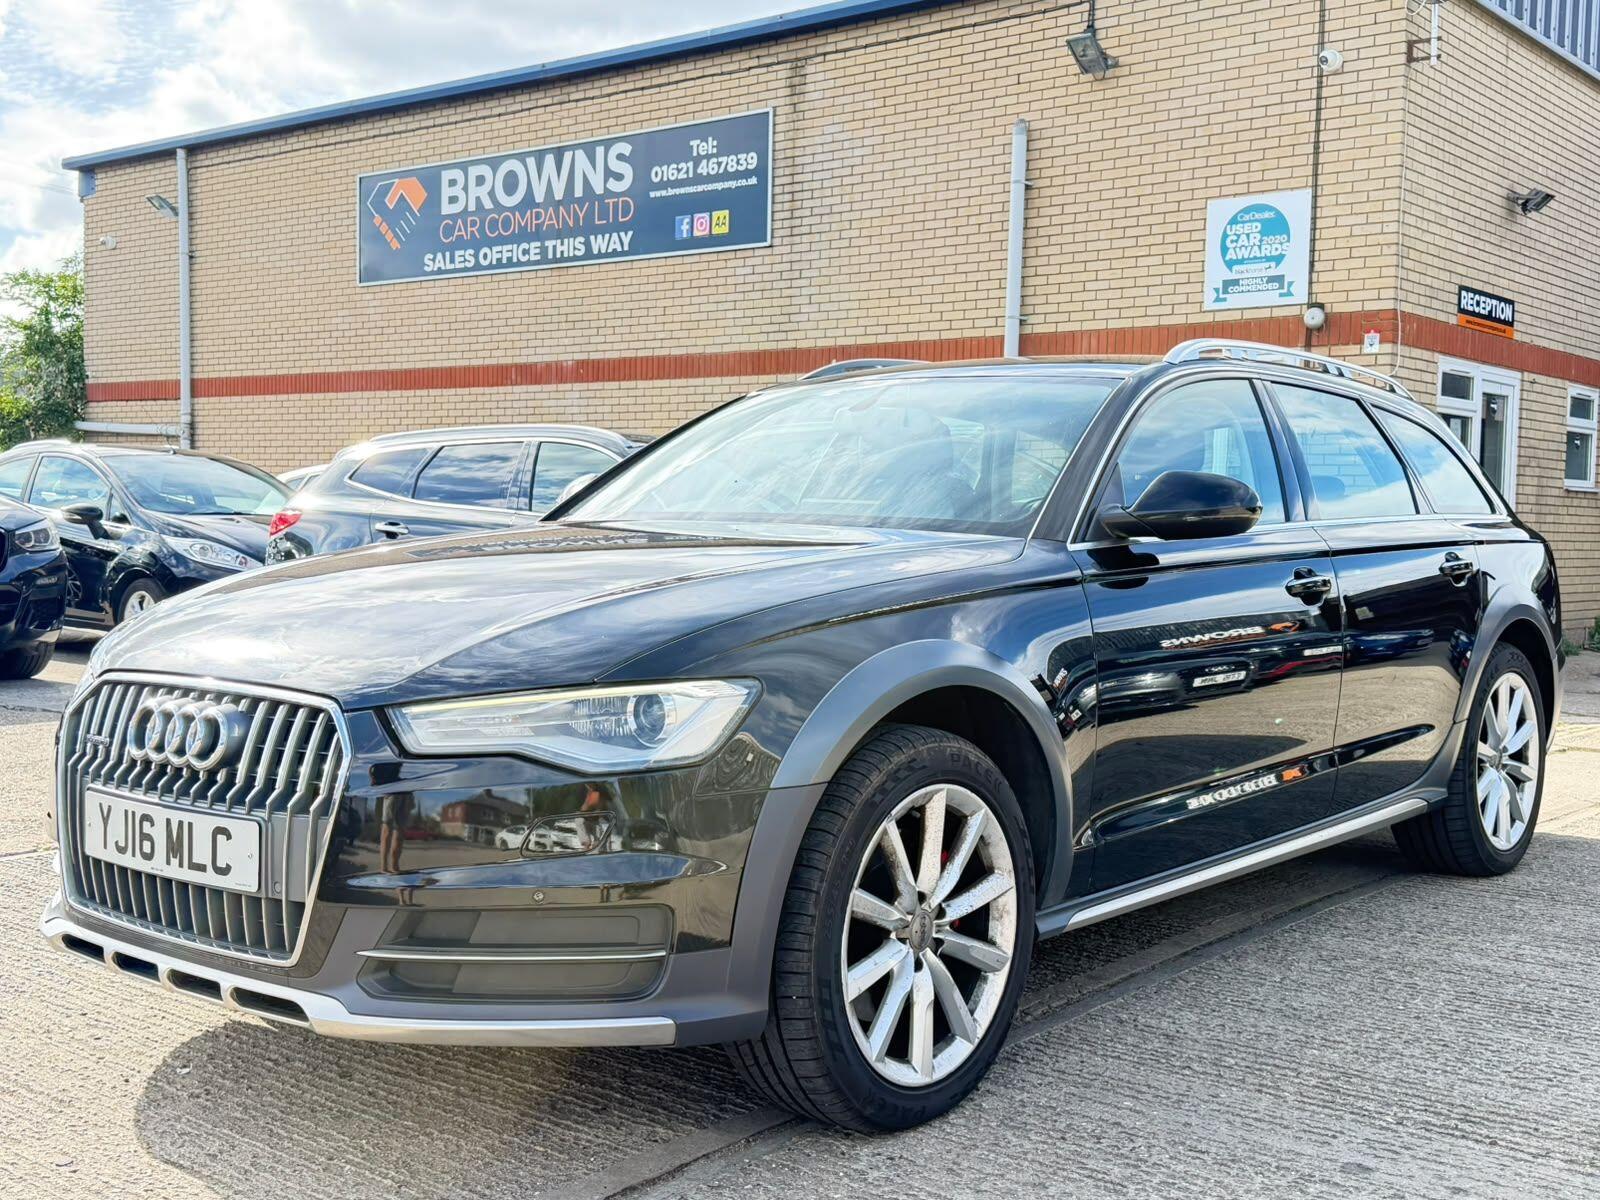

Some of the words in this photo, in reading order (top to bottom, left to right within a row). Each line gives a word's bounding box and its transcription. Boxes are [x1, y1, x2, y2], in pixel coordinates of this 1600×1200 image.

[689, 136, 717, 157] Tel:
[440, 141, 634, 216] BROWNS
[650, 161, 694, 183] 01621
[697, 152, 758, 176] 467839
[649, 176, 758, 198] www.brownscarcompany.co.uk
[439, 217, 480, 244] CAR
[485, 202, 588, 238] COMPANY
[594, 197, 635, 225] LTD
[1226, 222, 1261, 235] USED
[424, 249, 475, 272] SALES
[479, 241, 541, 266] OFFICE
[545, 236, 586, 259] THIS
[590, 231, 634, 255] WAY
[1225, 242, 1290, 260] AWARDS
[1226, 233, 1260, 248] CAR
[1262, 234, 1288, 245] 2020
[1228, 283, 1279, 293] COMMENDED
[1239, 276, 1268, 286] HIGHLY
[1461, 290, 1513, 322] RECEPTION
[99, 802, 155, 862] YJ16
[166, 817, 232, 877] MLC
